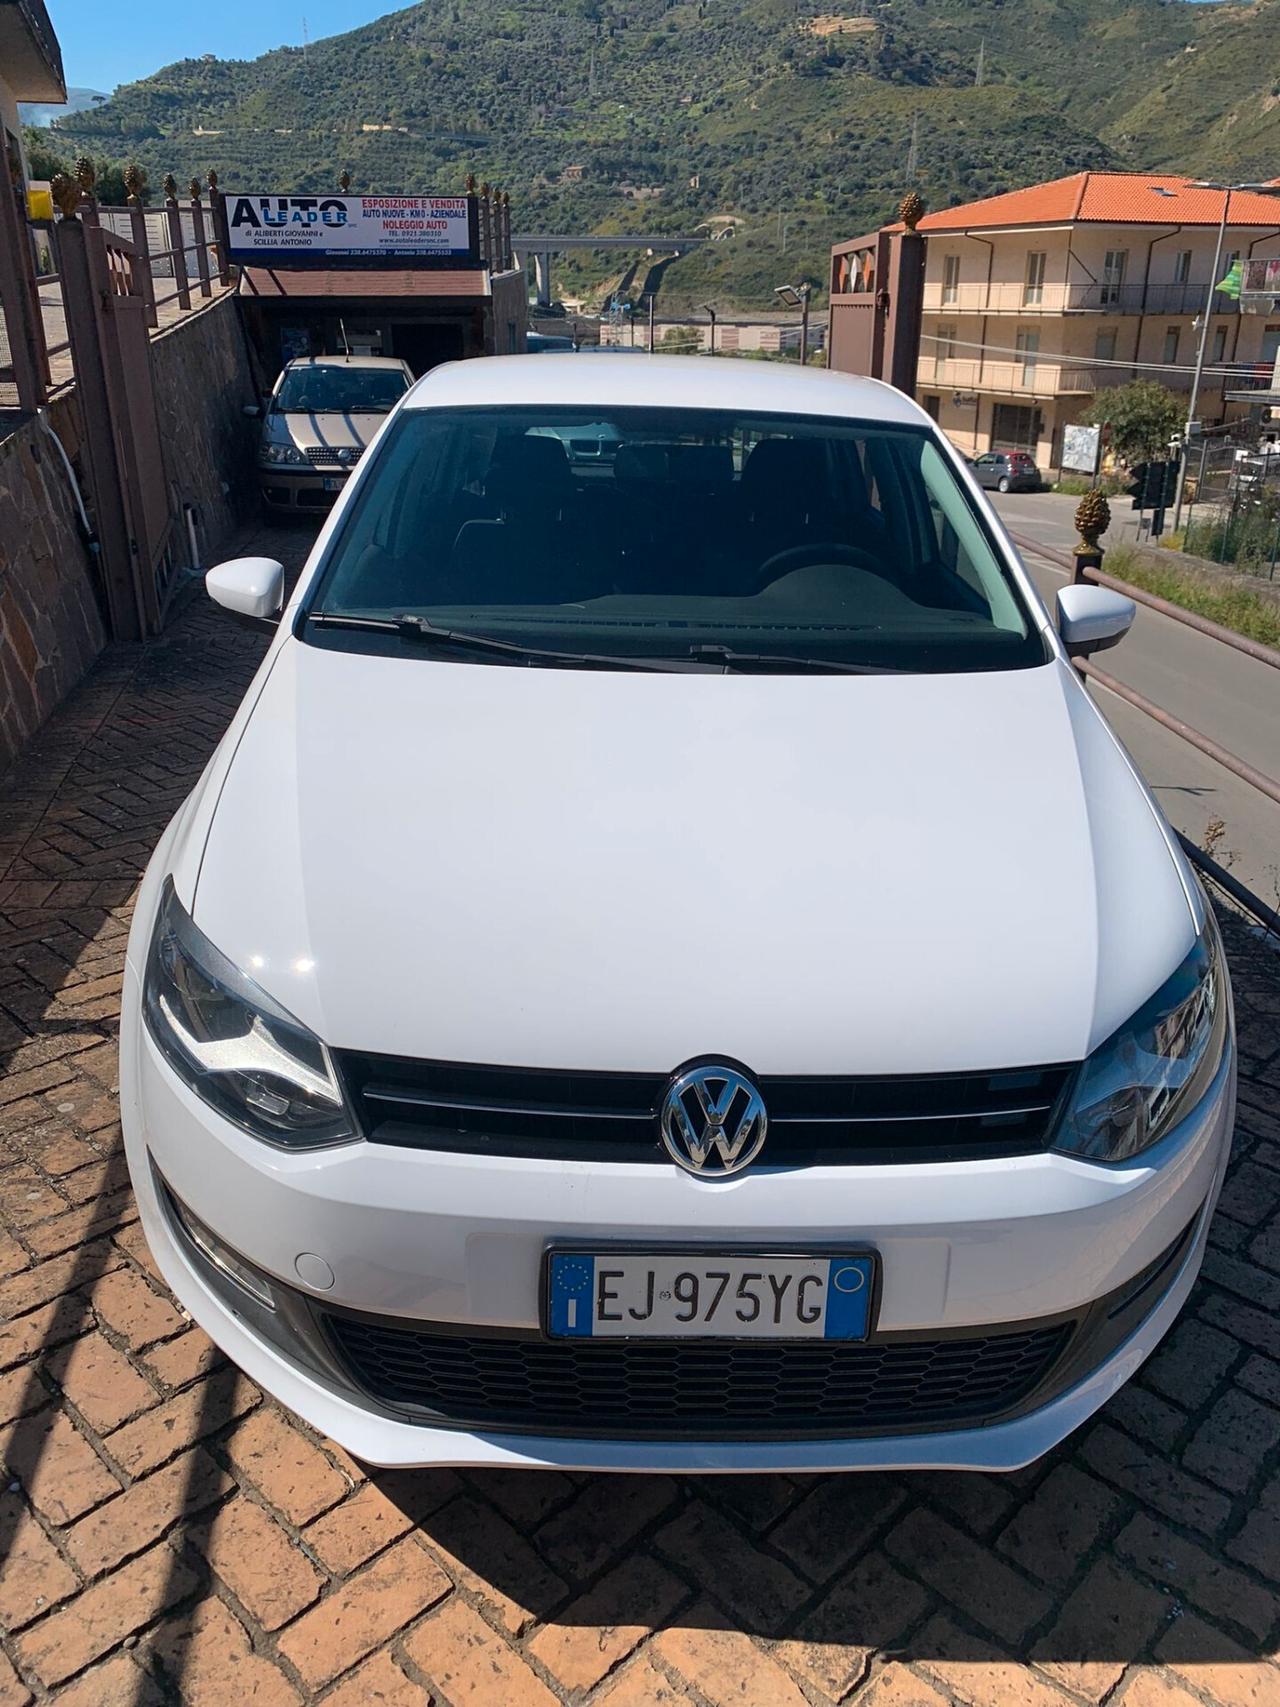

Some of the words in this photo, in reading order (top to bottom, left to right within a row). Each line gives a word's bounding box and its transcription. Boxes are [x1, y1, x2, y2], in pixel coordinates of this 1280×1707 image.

[362, 200, 418, 209] ESPOSIZIONE
[421, 200, 427, 209] E
[430, 200, 466, 209] VENDITA
[231, 199, 348, 228] AUTO
[263, 208, 349, 222] LEADER
[362, 210, 380, 218] AUTO
[382, 210, 405, 218] NUOVE
[430, 210, 467, 218] AZIENDALE
[383, 221, 424, 230] NOLEGGIO
[426, 221, 448, 230] AUTO
